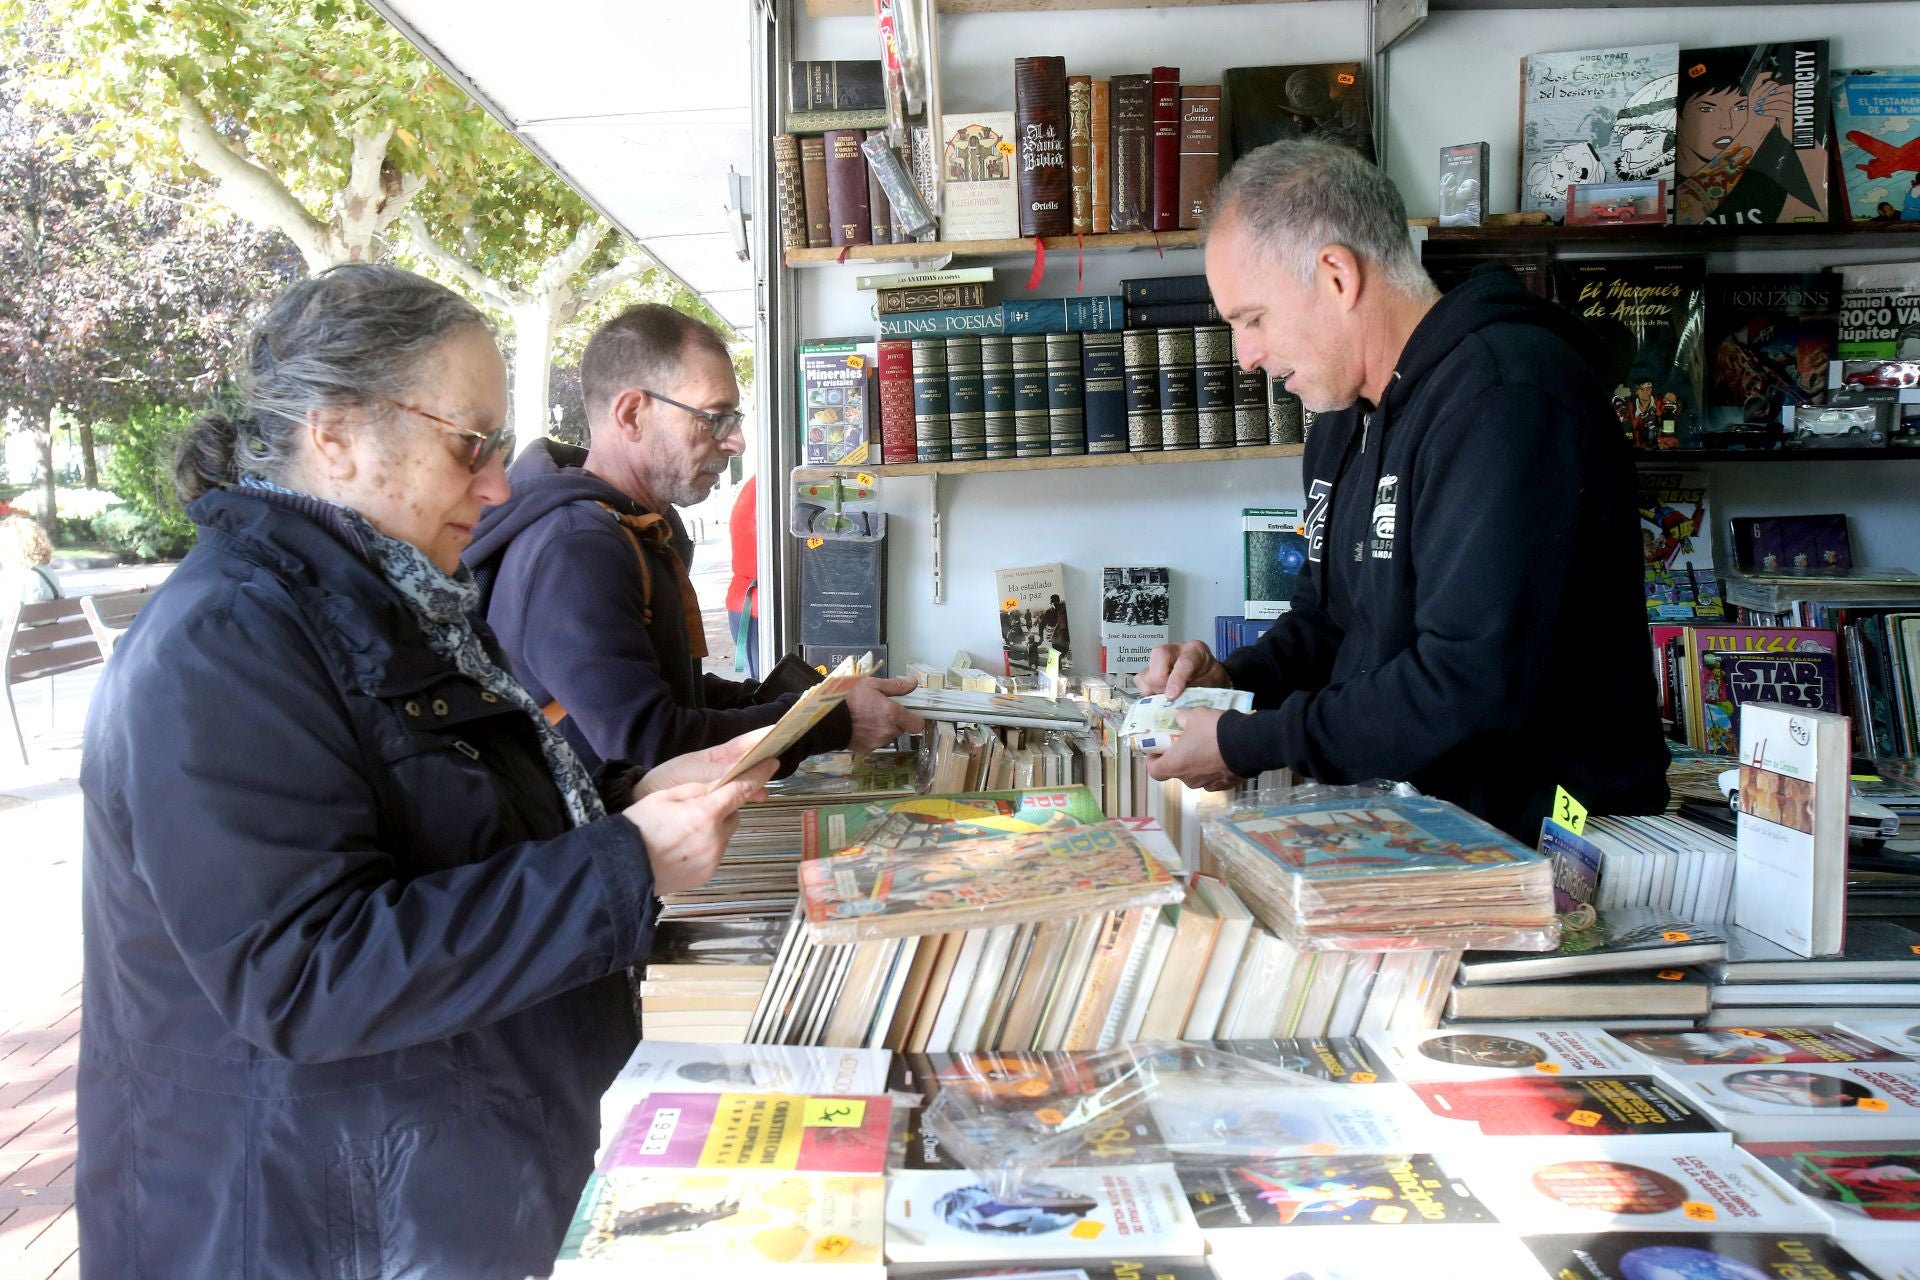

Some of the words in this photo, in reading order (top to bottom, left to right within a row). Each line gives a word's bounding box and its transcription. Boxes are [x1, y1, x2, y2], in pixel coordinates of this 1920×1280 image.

[1573, 64, 1642, 86] Escorpiones
[1540, 86, 1555, 99] del
[1560, 87, 1605, 98] desierto
[1794, 50, 1816, 126] MOTORCITY
[1192, 105, 1208, 114] Julio
[1858, 98, 1870, 106] EL
[1868, 106, 1880, 114] DE
[1184, 113, 1215, 122] Cortázar
[1026, 124, 1056, 139] La
[1023, 137, 1064, 154] Santa
[1023, 152, 1065, 171] Biblia
[1579, 281, 1602, 301] El
[1607, 279, 1682, 301] Marqués
[1583, 302, 1605, 318] de
[1611, 299, 1673, 321] Anaon
[1839, 308, 1892, 327] ROCO
[880, 318, 936, 335] SALINAS
[946, 313, 1002, 331] POESIAS
[807, 368, 862, 380] Minerales
[823, 379, 854, 387] cristales
[1753, 523, 1761, 538] 6
[1021, 581, 1052, 590] estallado
[1029, 593, 1042, 601] paz
[1734, 660, 1822, 685] STAR
[1731, 683, 1822, 710] WARS
[1560, 795, 1579, 831] 3€
[645, 1111, 674, 1152] 1931
[1683, 1155, 1708, 1168] LOS
[1388, 1161, 1446, 1220] Principito
